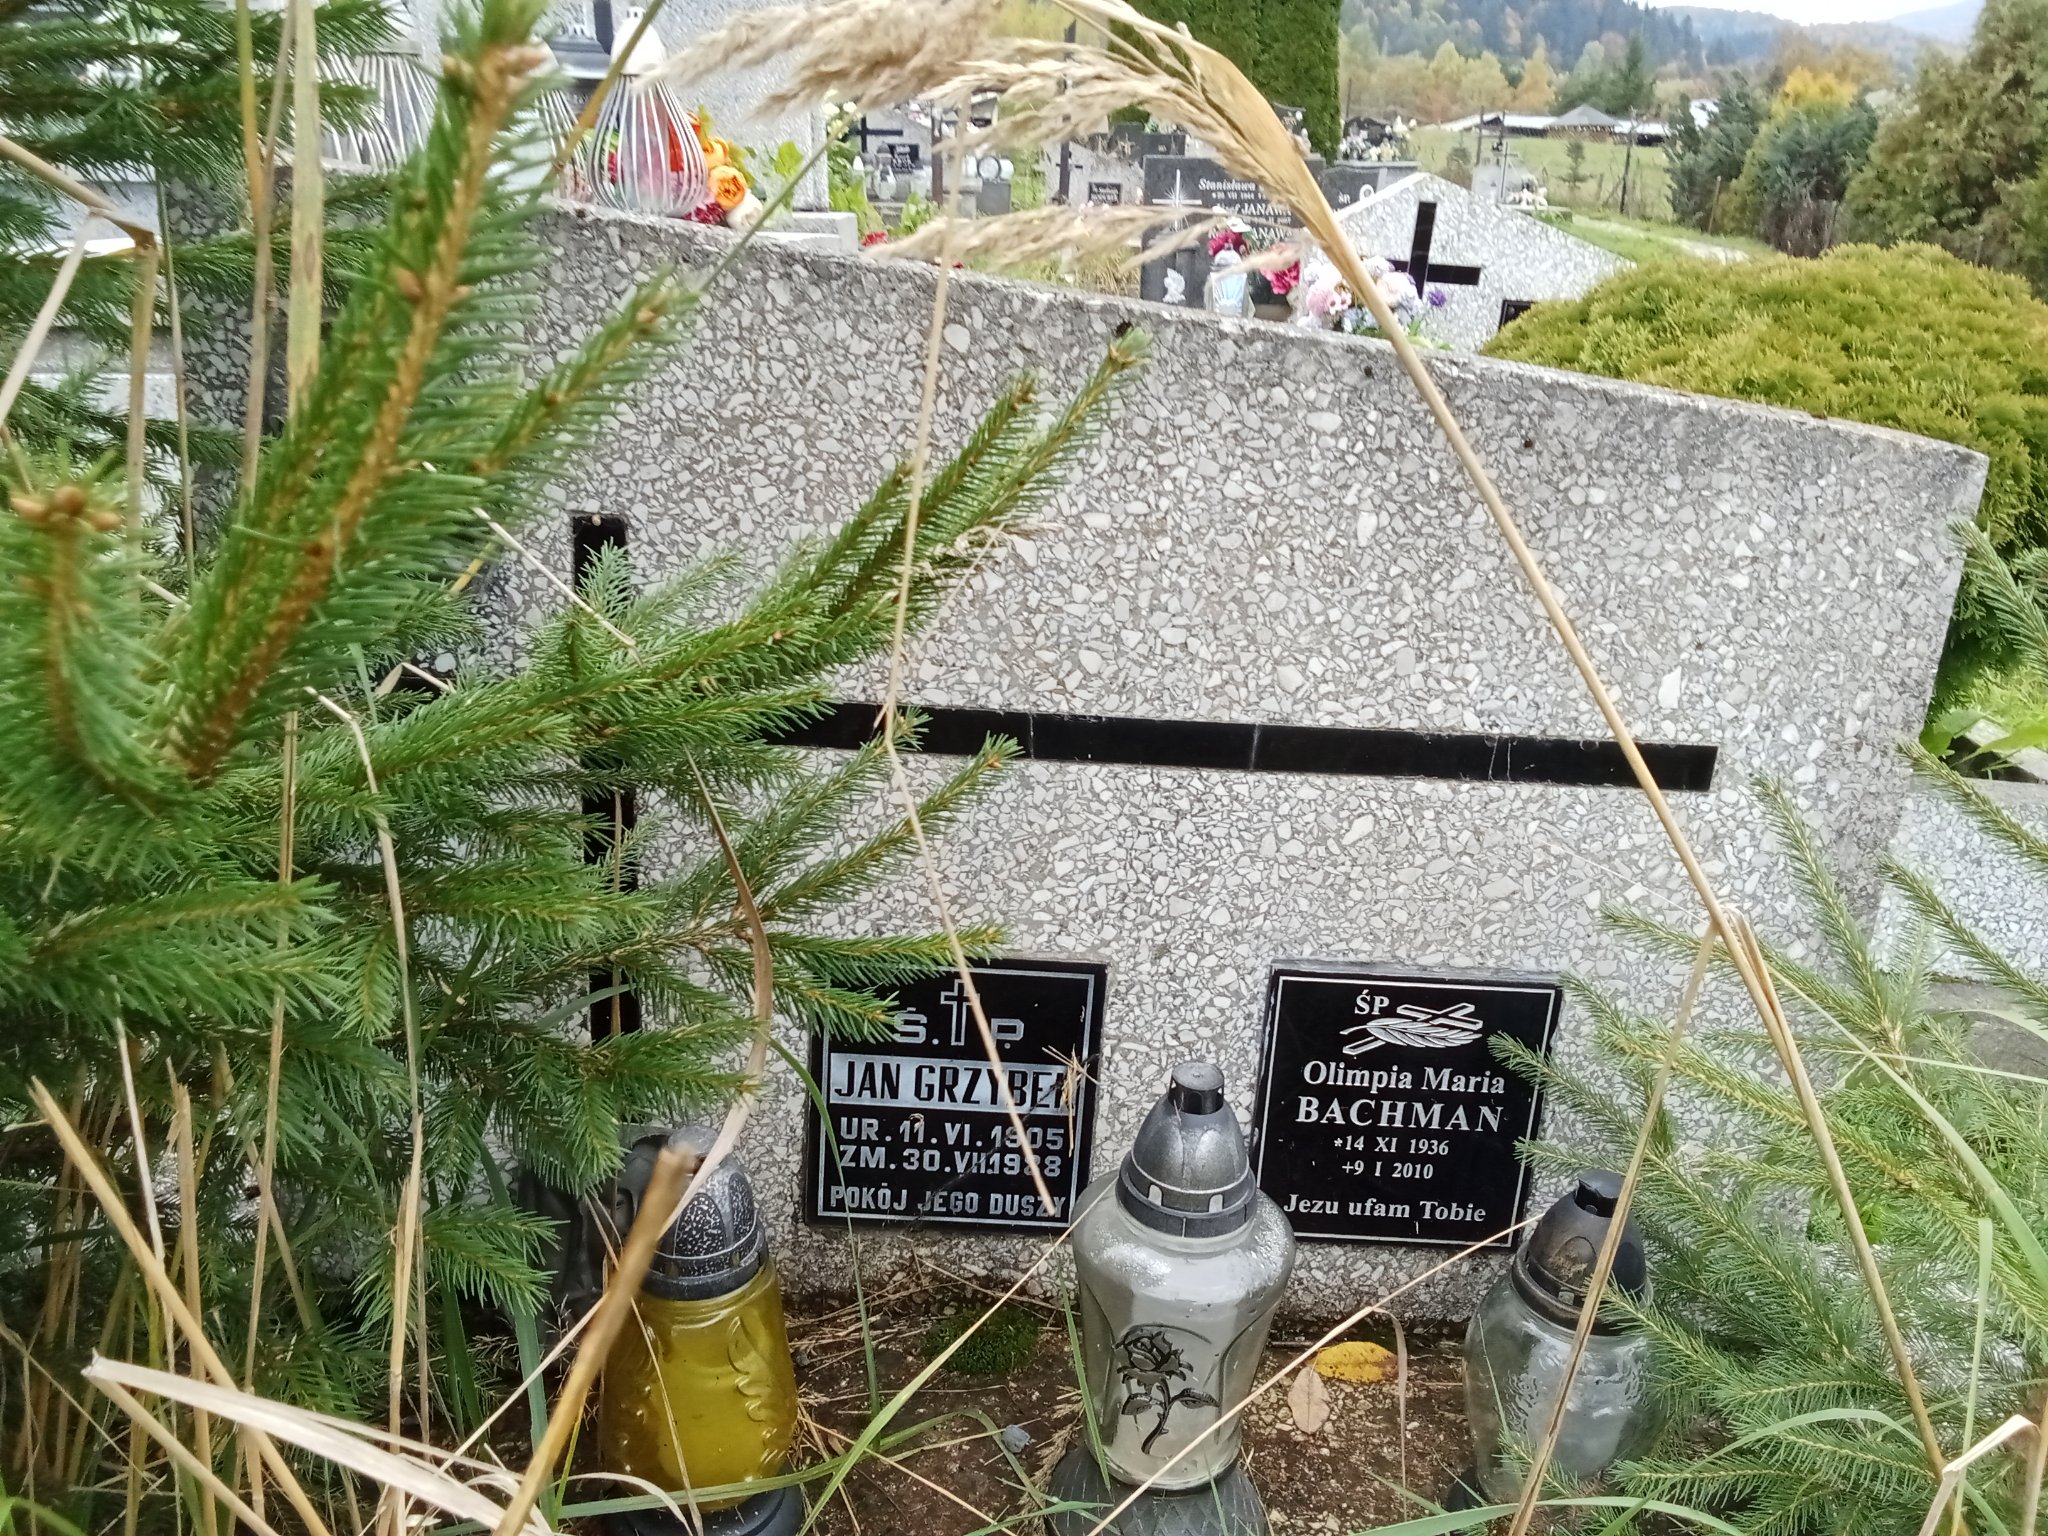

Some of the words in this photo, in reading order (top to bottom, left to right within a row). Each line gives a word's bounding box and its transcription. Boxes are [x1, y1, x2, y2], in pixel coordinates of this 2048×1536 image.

[1354, 989, 1390, 1015] ŚP
[834, 1060, 901, 1100] JAN
[1303, 1060, 1413, 1094] Olimpia
[1420, 1066, 1506, 1094] Maria
[1295, 1095, 1504, 1133] BACHMAN
[990, 1125, 1065, 1150] 1905
[1374, 1137, 1398, 1153] XI
[1409, 1138, 1450, 1155] 1936
[1374, 1161, 1382, 1177] I
[1392, 1162, 1434, 1179] 2010
[830, 1182, 908, 1211] POKÓJ
[917, 1189, 979, 1215] JEGO
[989, 1193, 1066, 1218] DUSZY
[1283, 1194, 1339, 1215] Jezu
[1348, 1197, 1410, 1218] ufam
[1419, 1201, 1487, 1222] Tobie
